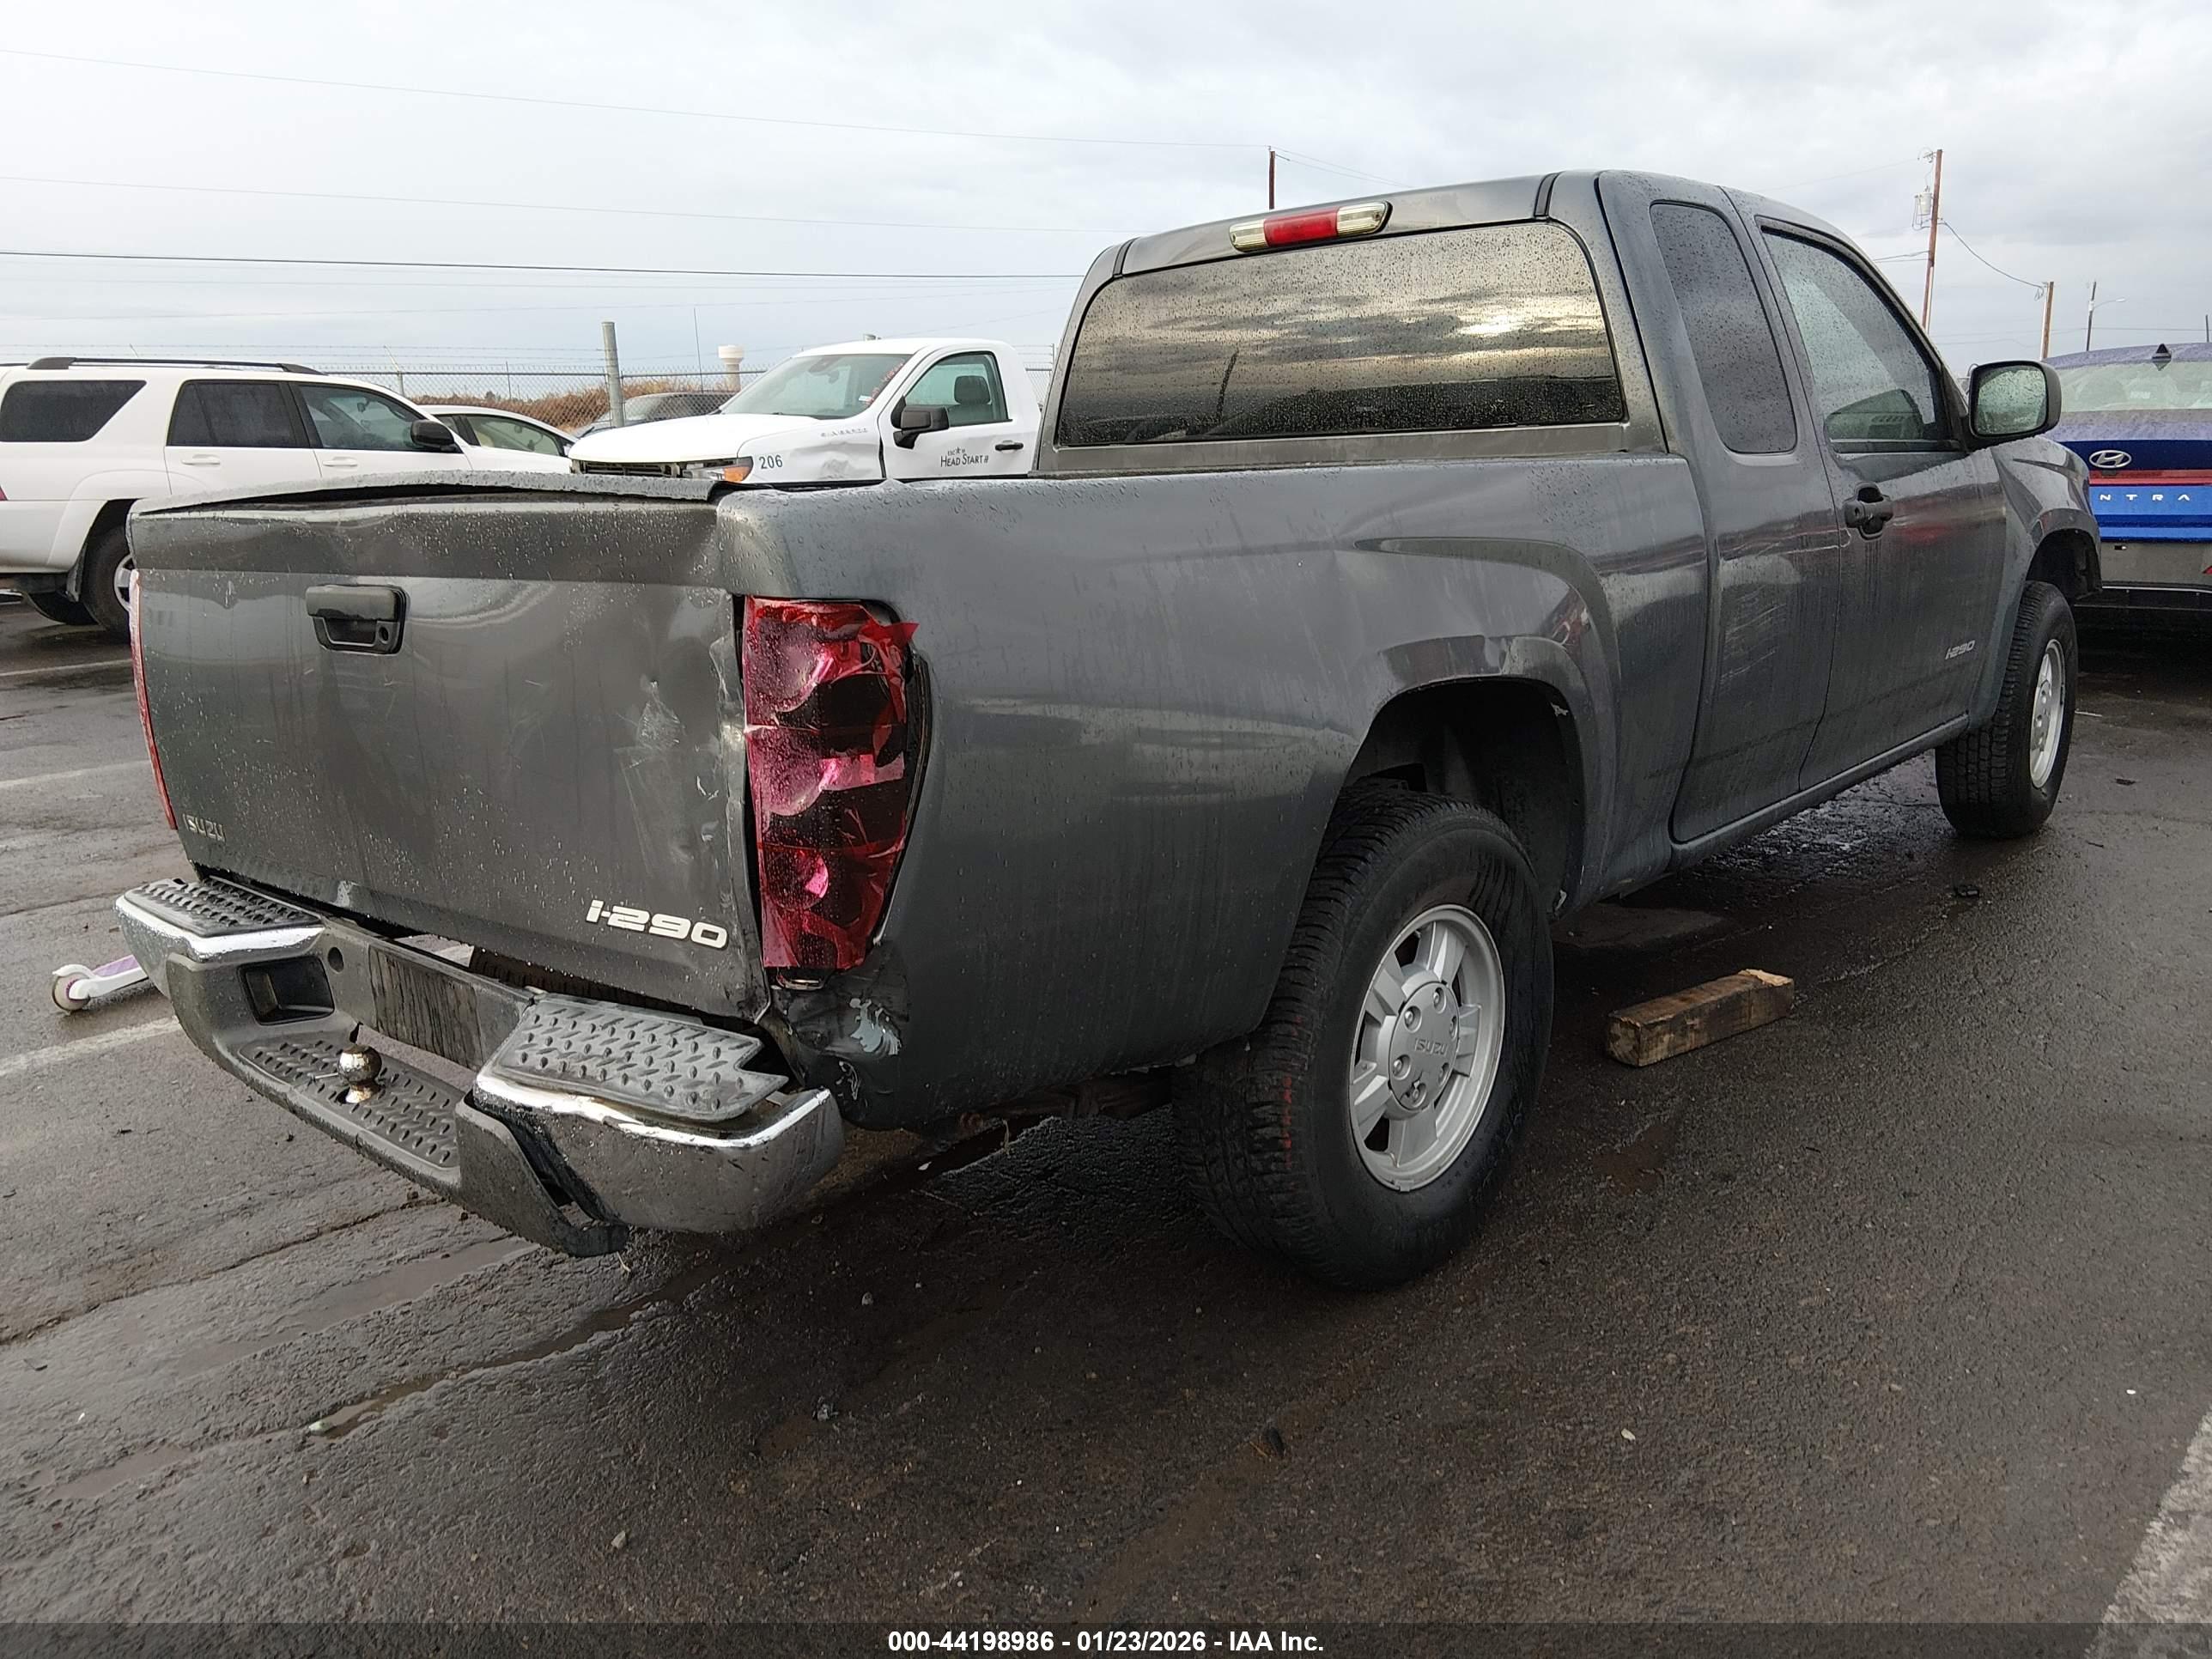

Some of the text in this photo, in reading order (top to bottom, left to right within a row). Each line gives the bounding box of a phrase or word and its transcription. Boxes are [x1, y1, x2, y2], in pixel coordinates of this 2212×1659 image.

[758, 454, 783, 470] 206
[182, 812, 226, 842] ISUZU
[1414, 1037, 1449, 1056] ISUZU
